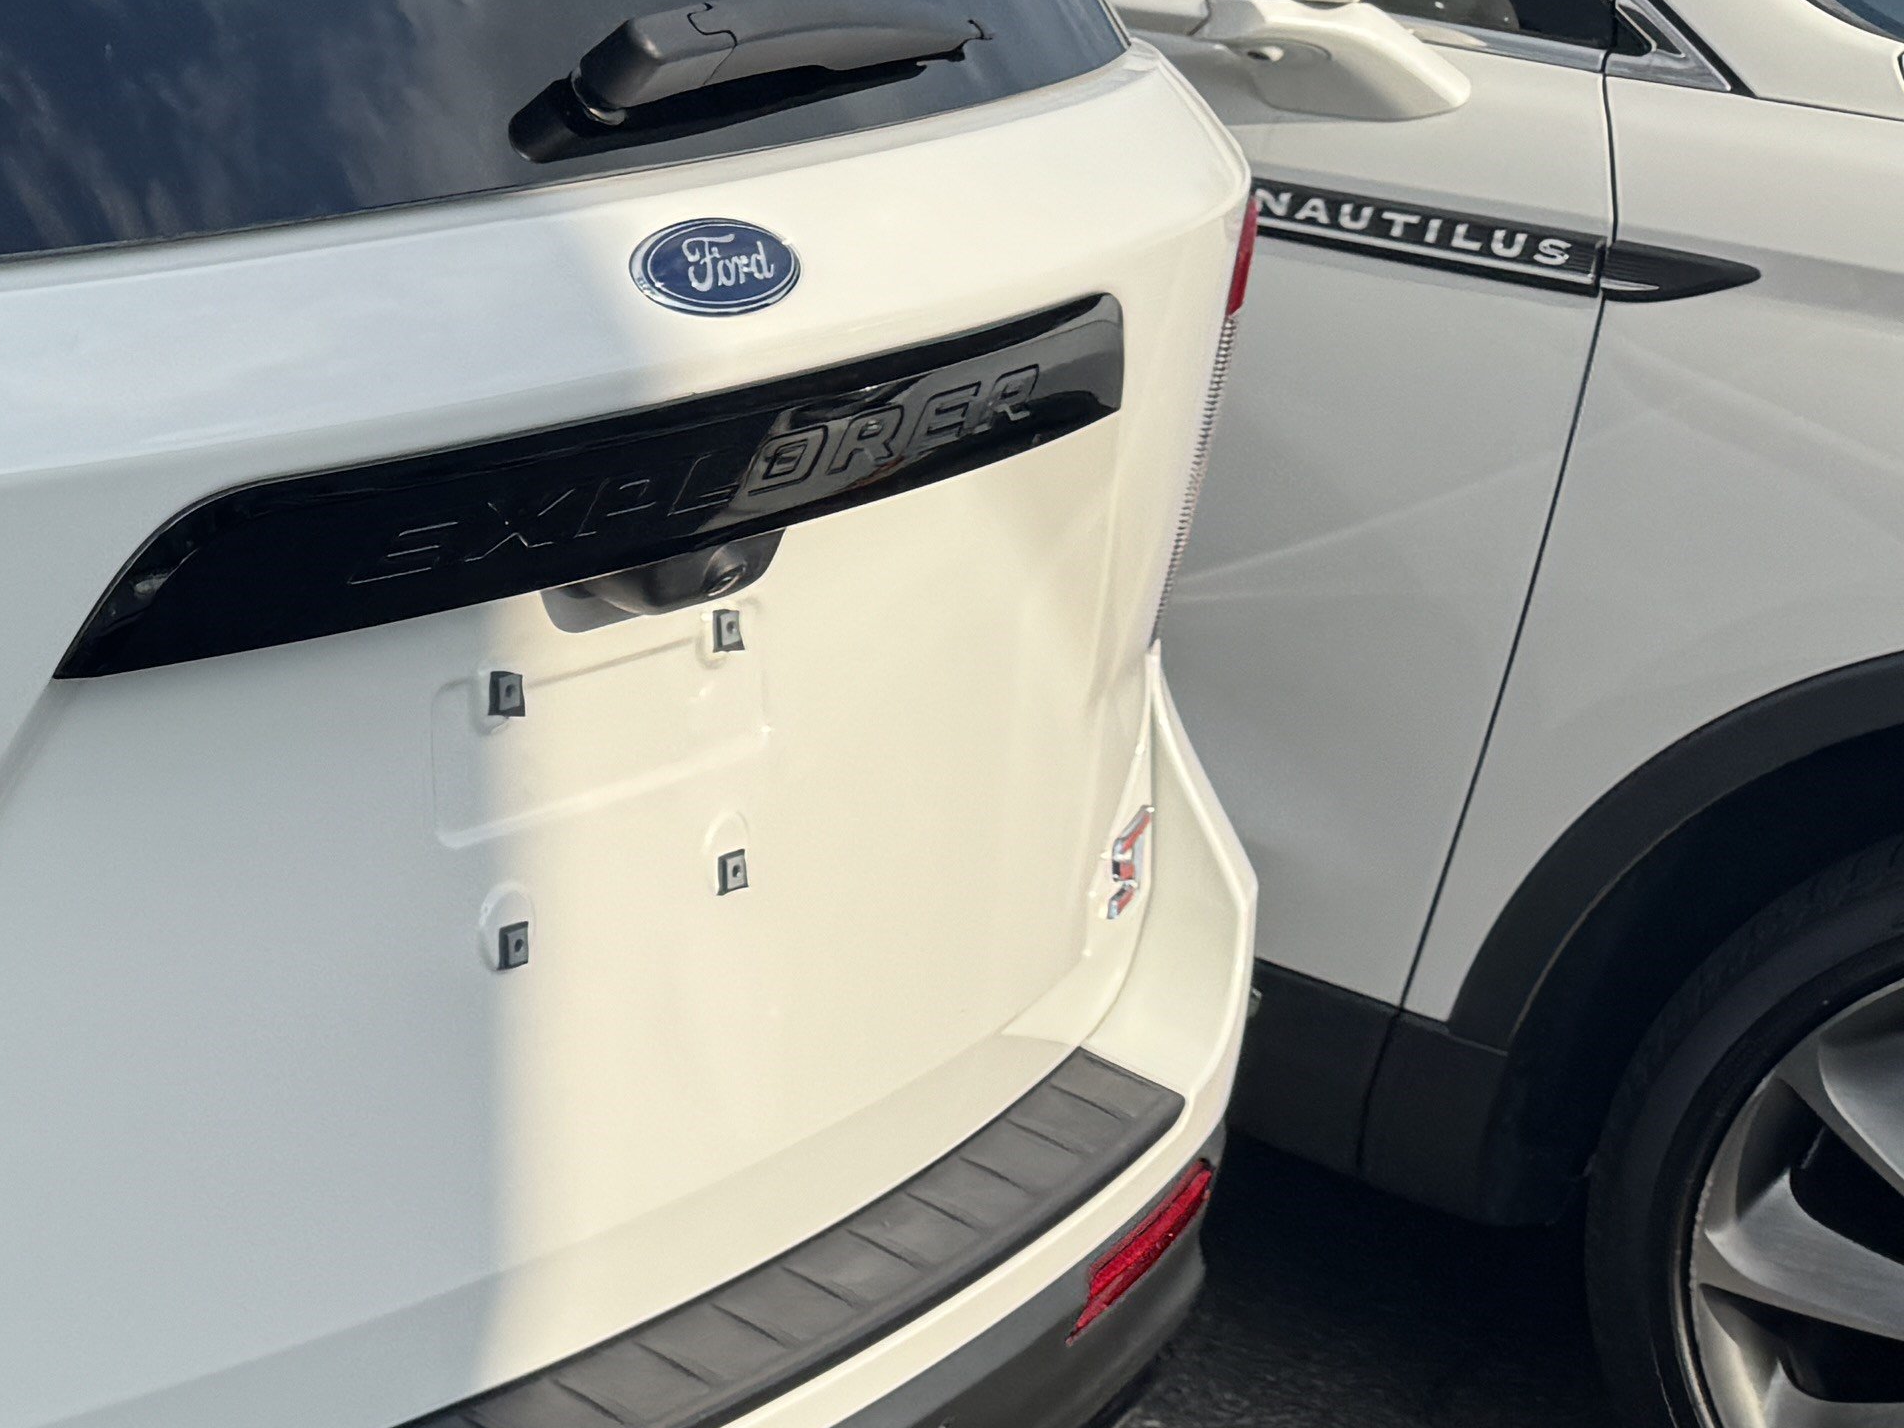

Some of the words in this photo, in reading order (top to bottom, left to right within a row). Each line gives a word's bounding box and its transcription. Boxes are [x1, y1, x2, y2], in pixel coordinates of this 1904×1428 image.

[681, 233, 774, 292] Ford
[1254, 188, 1570, 267] NAUTILUS
[347, 363, 1040, 586] EXPLORER
